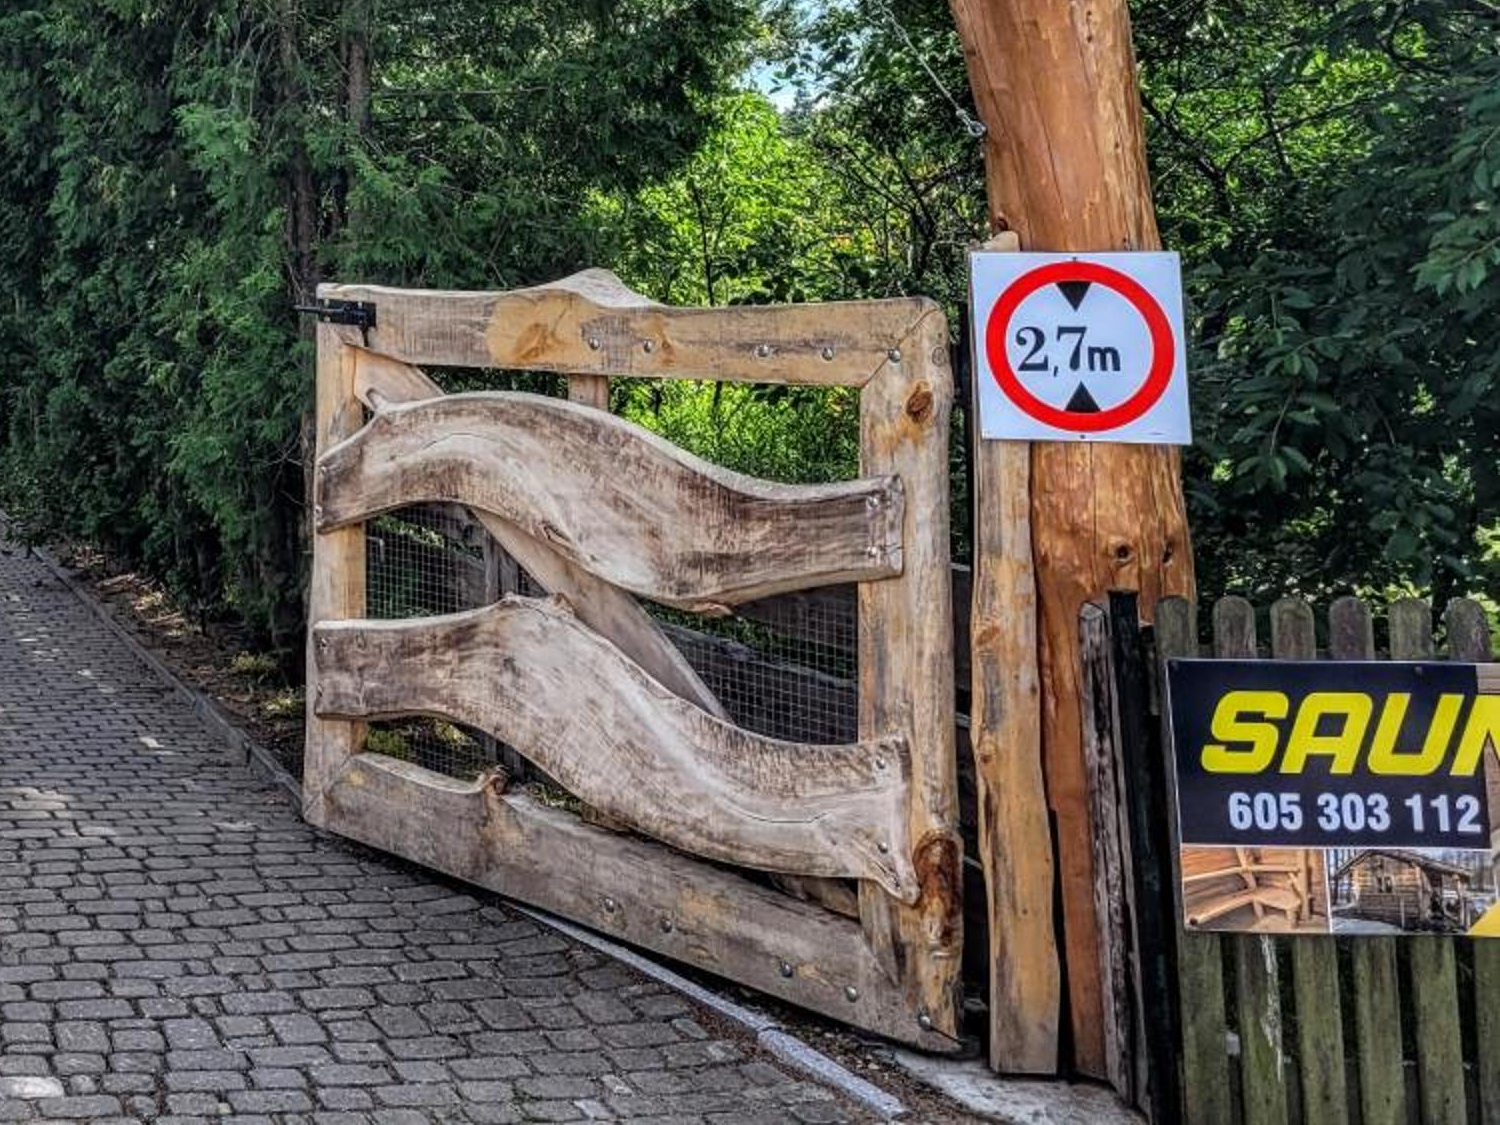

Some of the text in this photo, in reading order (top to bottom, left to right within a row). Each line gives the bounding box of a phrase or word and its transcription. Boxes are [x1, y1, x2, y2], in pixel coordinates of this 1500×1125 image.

[1228, 791, 1482, 833] 605 303 112
